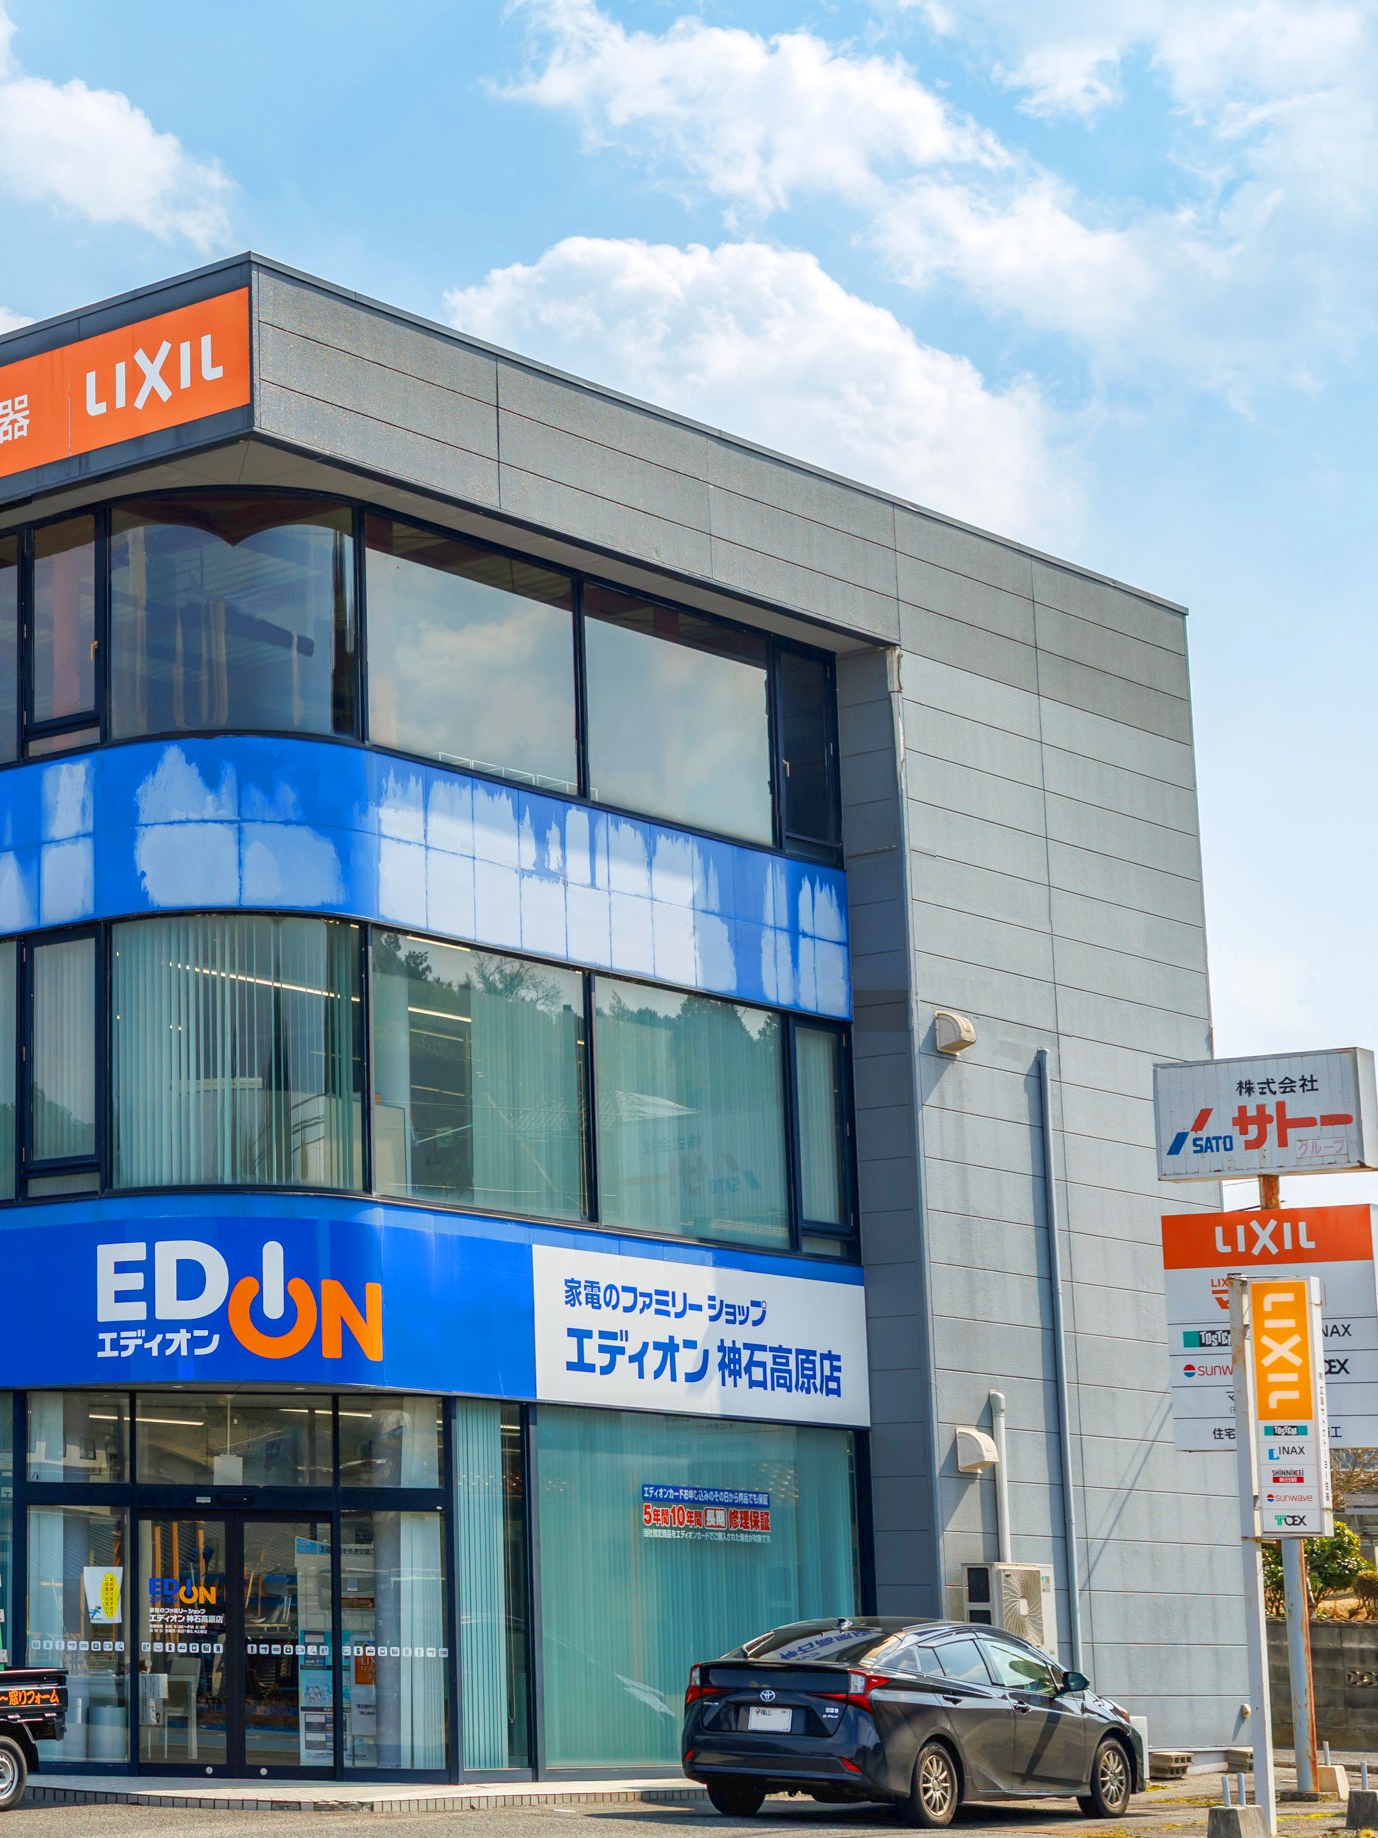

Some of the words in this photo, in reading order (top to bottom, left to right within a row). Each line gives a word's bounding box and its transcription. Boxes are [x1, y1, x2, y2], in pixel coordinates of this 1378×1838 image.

[86, 334, 223, 417] LIXIL
[1235, 1074, 1319, 1097] 株式会社
[1232, 1101, 1353, 1150] サトー
[1192, 1135, 1234, 1154] SATO
[1215, 1219, 1316, 1256] LIXIL
[97, 1240, 383, 1362] EDION
[708, 1295, 767, 1327] ショップ
[97, 1329, 220, 1358] エディオン
[1260, 1293, 1302, 1409] LIXIL
[566, 1328, 709, 1383] エディオン
[717, 1338, 842, 1398] 神石高原店
[1213, 1428, 1236, 1440] 住宅
[1278, 1446, 1306, 1456] INAX
[149, 1578, 216, 1604] EDION
[149, 1614, 185, 1622] エディオン
